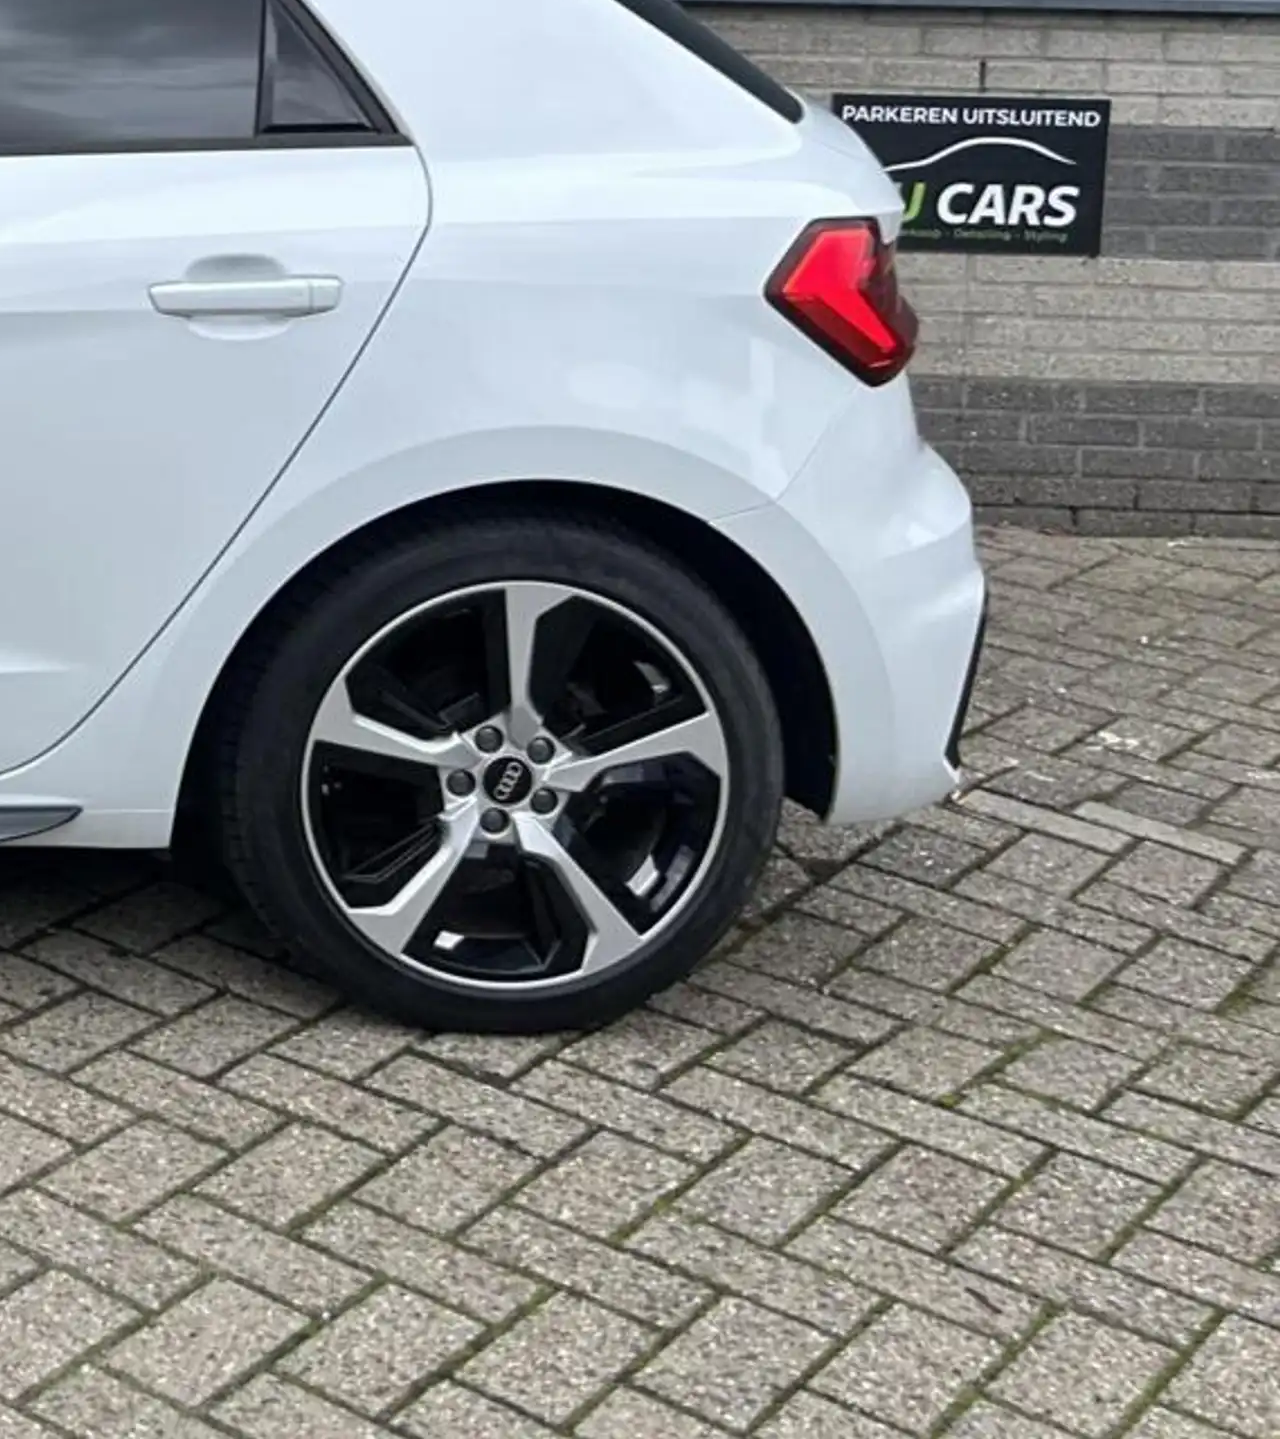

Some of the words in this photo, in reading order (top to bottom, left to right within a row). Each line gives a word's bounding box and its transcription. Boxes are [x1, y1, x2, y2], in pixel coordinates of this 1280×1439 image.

[842, 105, 958, 125] PARKEREN
[962, 108, 1101, 128] UITSLUITEND
[937, 182, 1080, 227] CARS
[954, 228, 1011, 241] Deing
